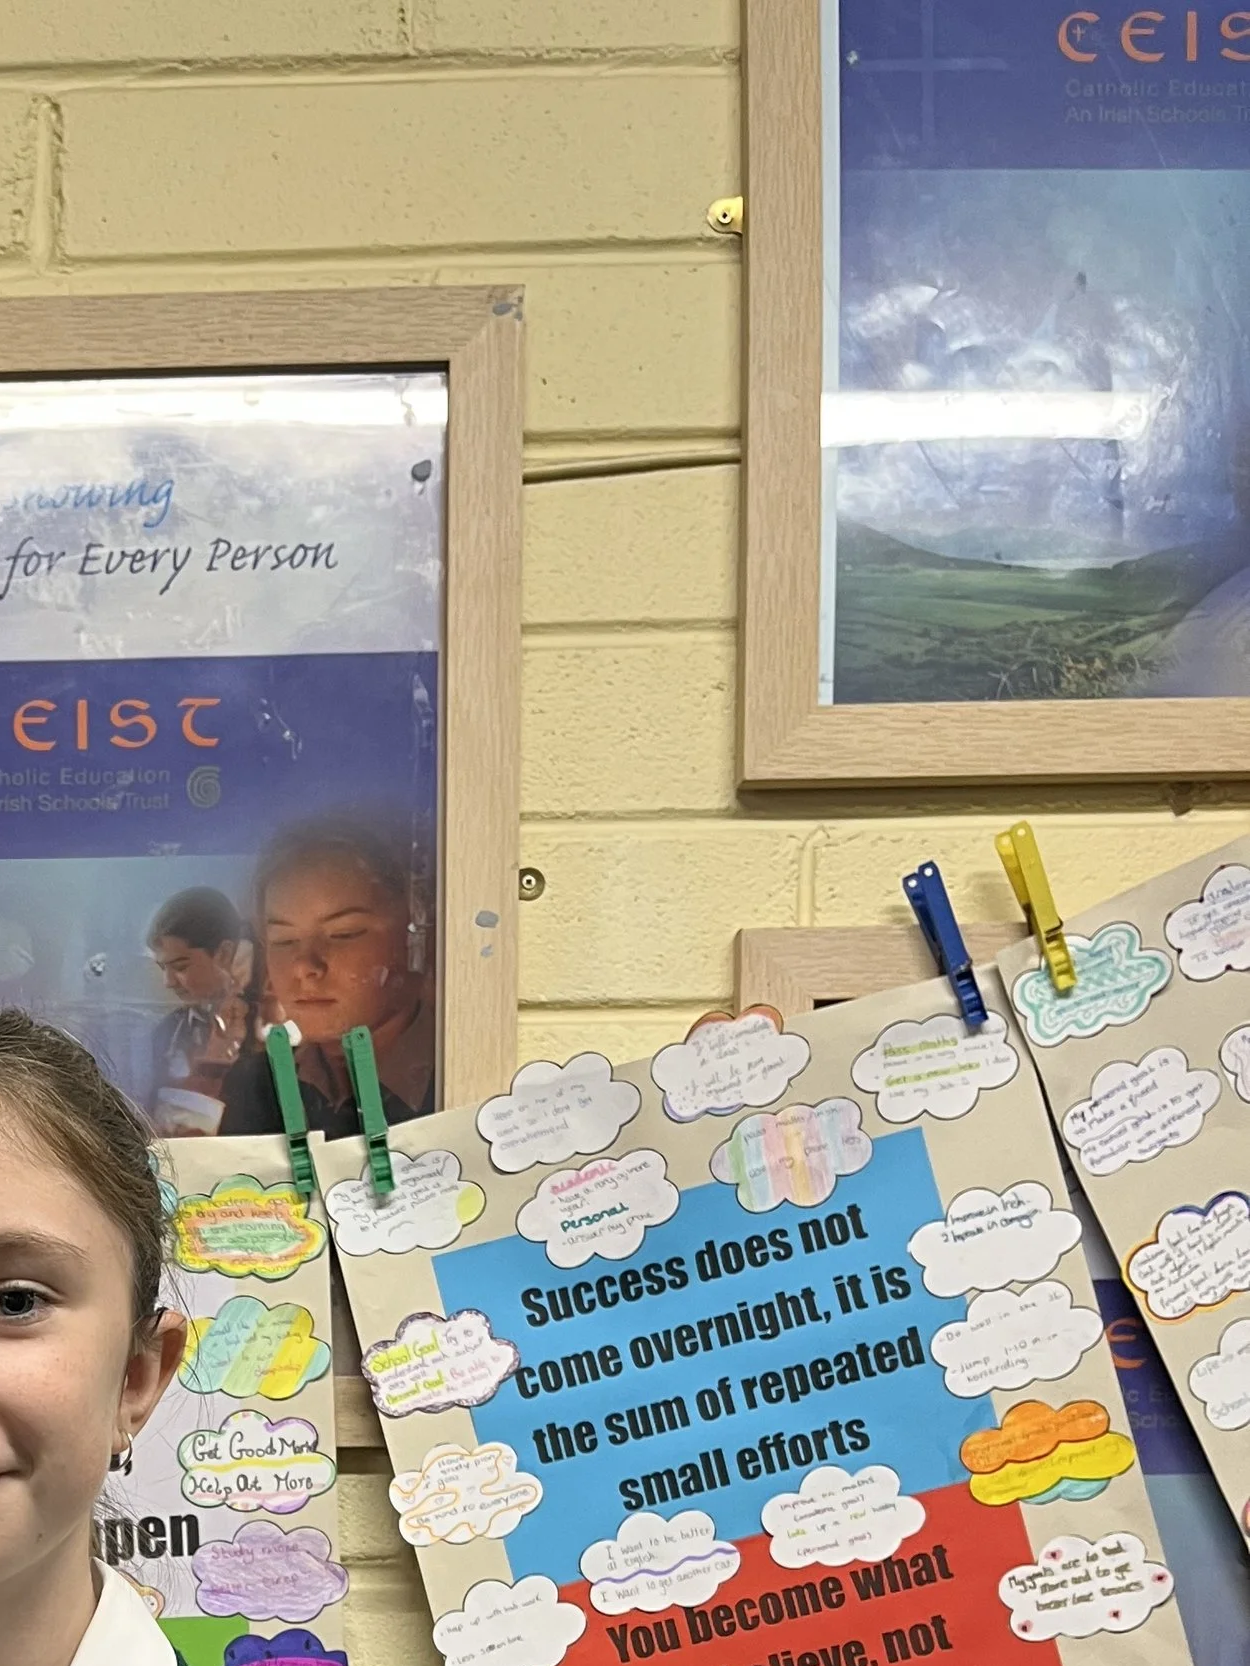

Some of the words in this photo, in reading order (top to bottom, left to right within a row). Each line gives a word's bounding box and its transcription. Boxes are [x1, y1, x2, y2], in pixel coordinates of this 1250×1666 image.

[1058, 10, 1250, 63] CEIS
[1064, 105, 1092, 124] An
[1065, 79, 1154, 99] Catholic
[1168, 79, 1250, 98] Educat
[4, 478, 175, 529] owing
[77, 544, 192, 596] Every
[205, 535, 339, 582] Person
[37, 791, 122, 814] Schools
[124, 790, 171, 811] Trust
[59, 765, 171, 789] Education
[520, 1255, 690, 1328] Success
[694, 1240, 794, 1284] does
[797, 1203, 869, 1257] not
[515, 1344, 624, 1401] come
[629, 1286, 832, 1371] overnight,
[833, 1271, 869, 1317] it
[869, 1264, 913, 1307] is
[532, 1422, 599, 1466] the
[604, 1394, 692, 1447] sum
[696, 1376, 734, 1423] of
[738, 1326, 926, 1412] repeated
[191, 1435, 221, 1462] Get
[229, 1431, 277, 1462] Good
[618, 1447, 732, 1512] small
[735, 1418, 872, 1482] efforts
[102, 1513, 201, 1568] pen
[606, 1617, 682, 1665] You
[683, 1574, 847, 1645] become
[848, 1544, 956, 1602] what
[881, 1613, 954, 1666] not
